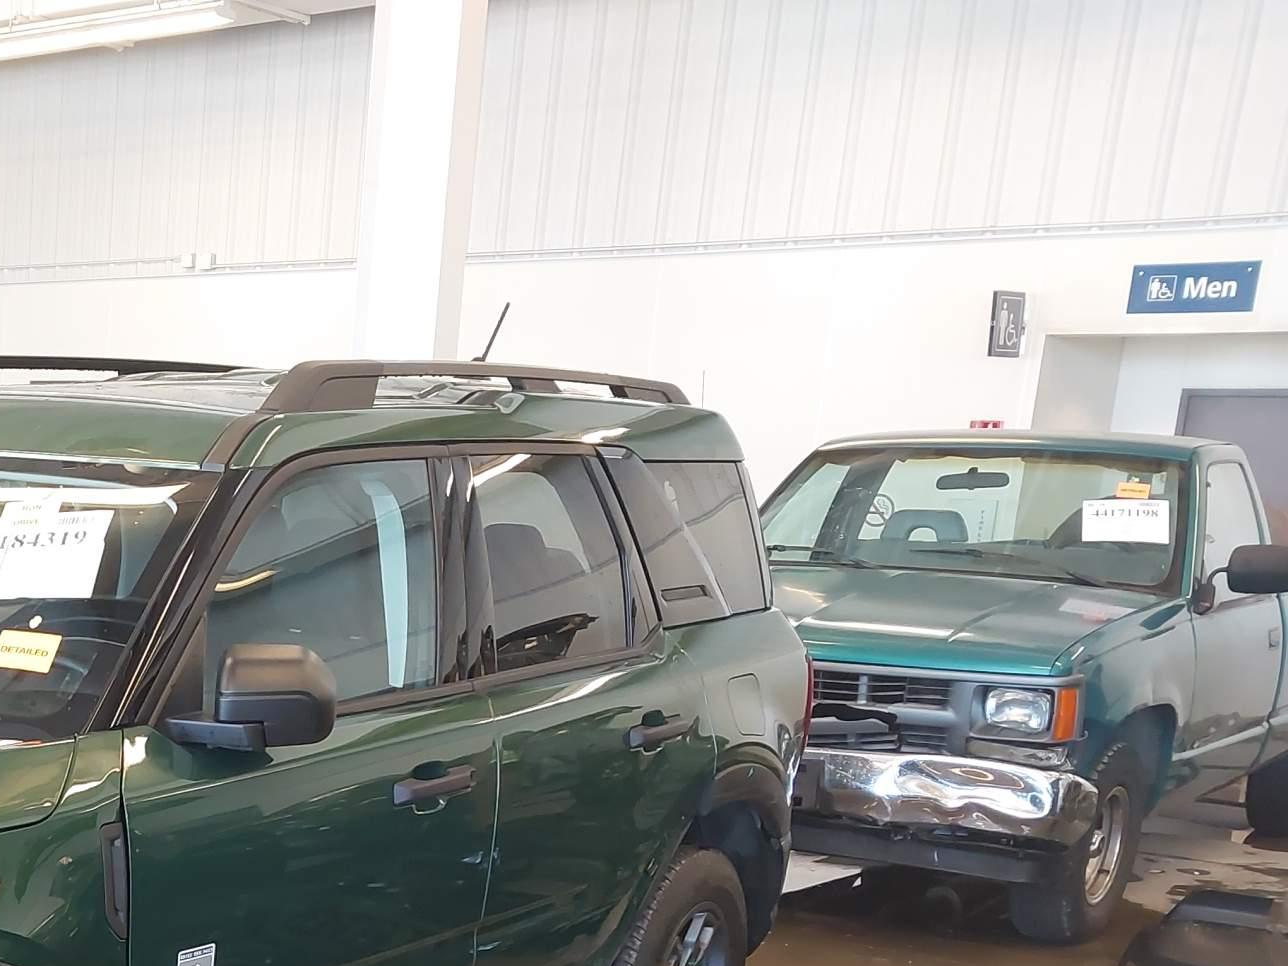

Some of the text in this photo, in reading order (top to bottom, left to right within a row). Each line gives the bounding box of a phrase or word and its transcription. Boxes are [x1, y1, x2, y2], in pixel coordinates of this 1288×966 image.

[1182, 276, 1238, 299] Men
[1091, 508, 1159, 518] 44171198
[0, 645, 49, 657] DETAILED
